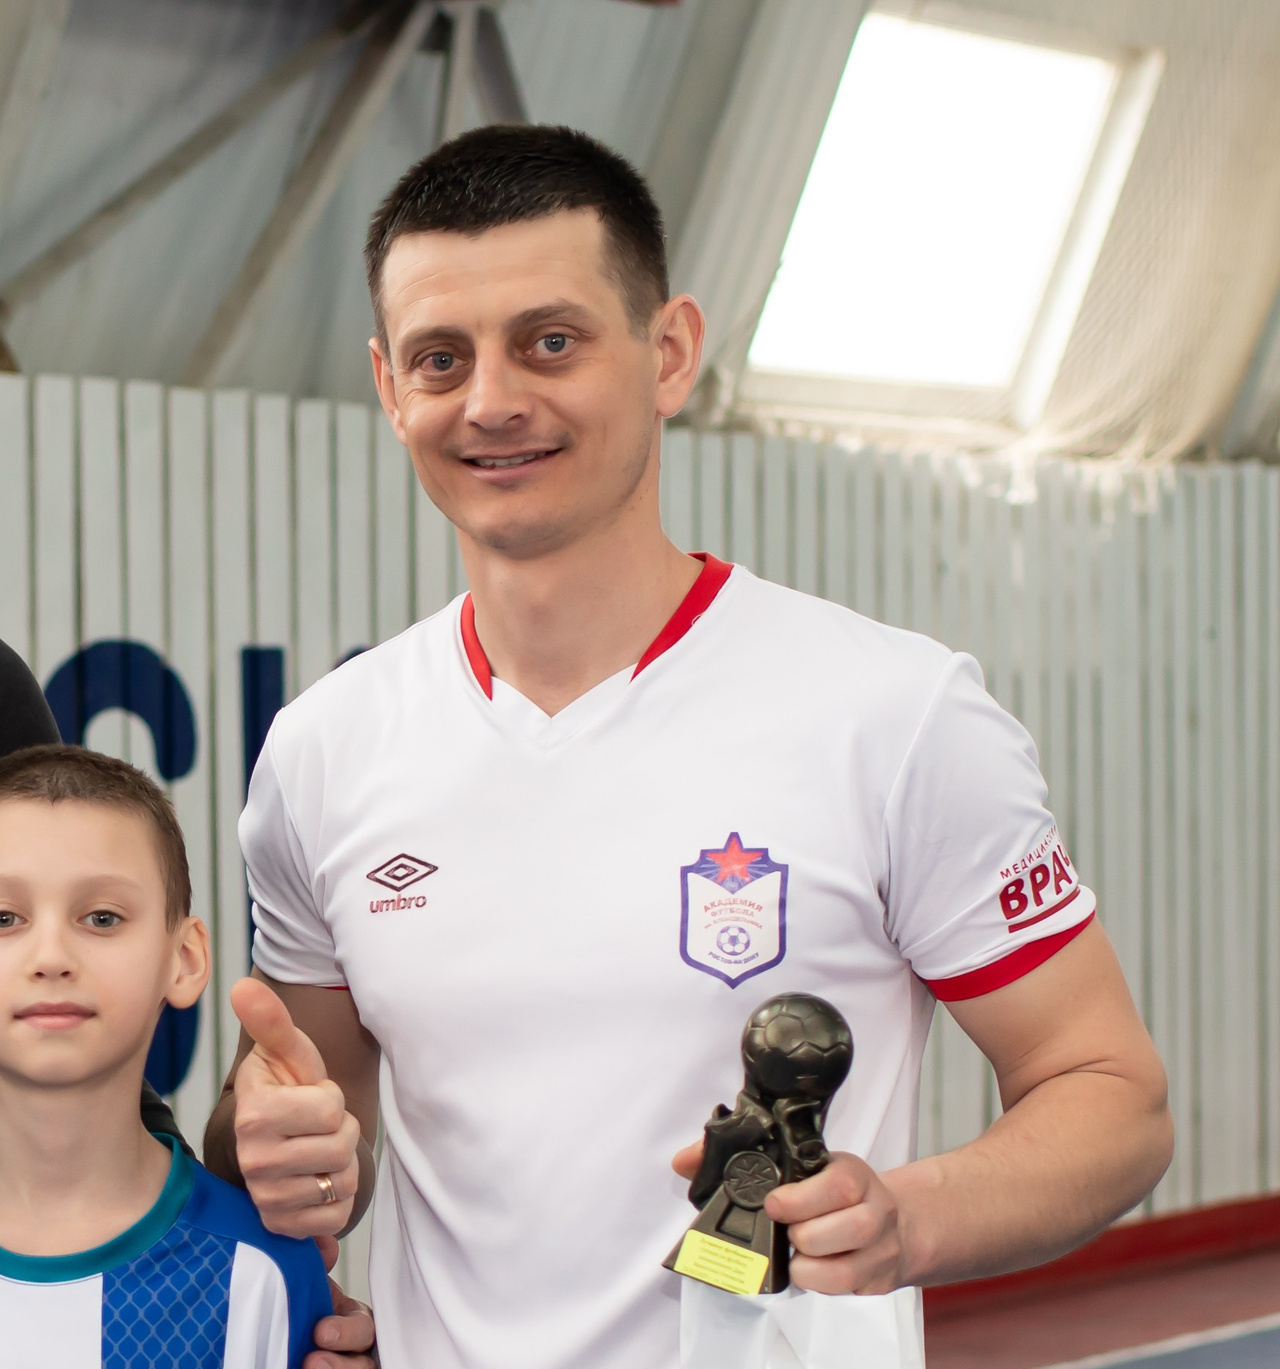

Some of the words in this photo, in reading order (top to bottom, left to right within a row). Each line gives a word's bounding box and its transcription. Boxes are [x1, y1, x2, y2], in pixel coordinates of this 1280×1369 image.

[370, 894, 427, 913] umbro
[703, 897, 763, 913] АКАДЕМИЯ
[710, 907, 754, 918] ФУТБОЛА
